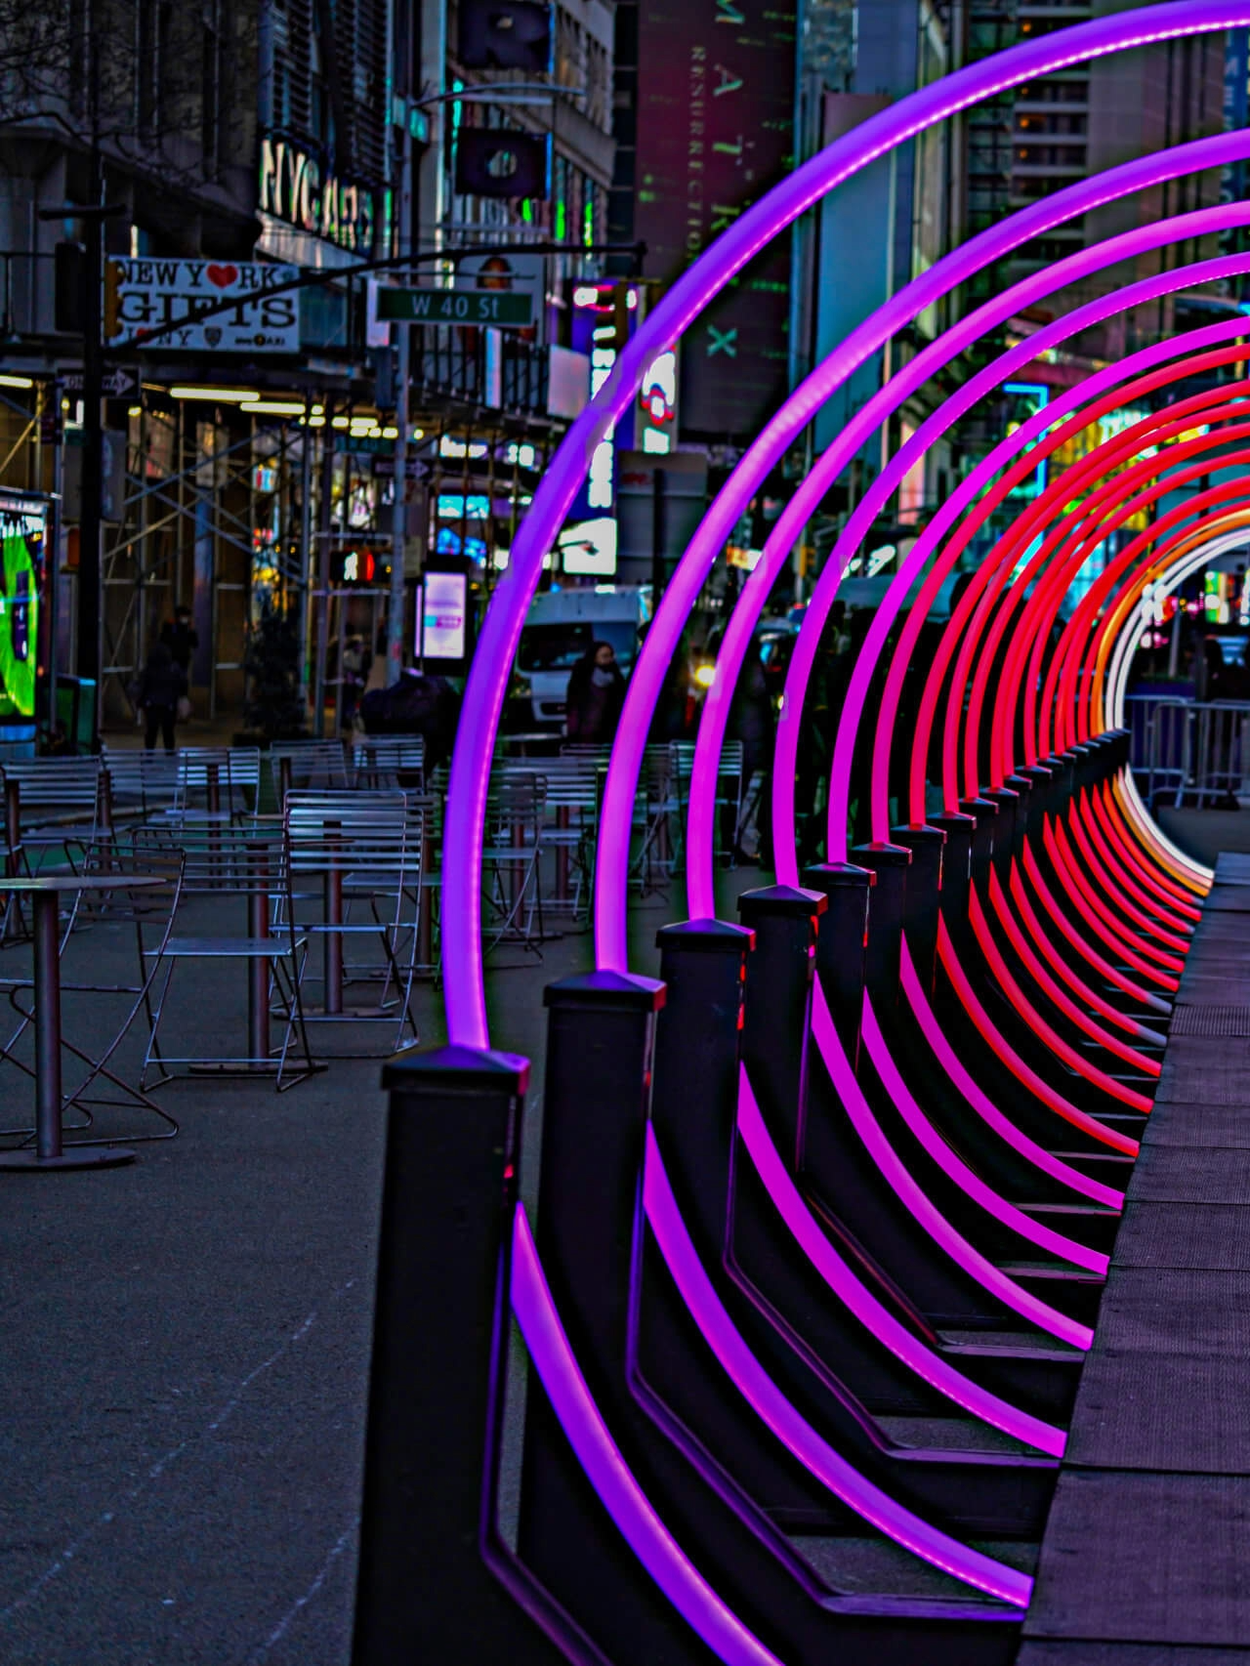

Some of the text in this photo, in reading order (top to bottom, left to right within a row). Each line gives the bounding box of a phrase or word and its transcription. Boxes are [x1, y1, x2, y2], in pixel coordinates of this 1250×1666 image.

[706, 0, 746, 359] MATRX
[117, 260, 179, 285] NEW
[118, 291, 296, 328] GIFTS
[412, 295, 499, 319] W 40 St
